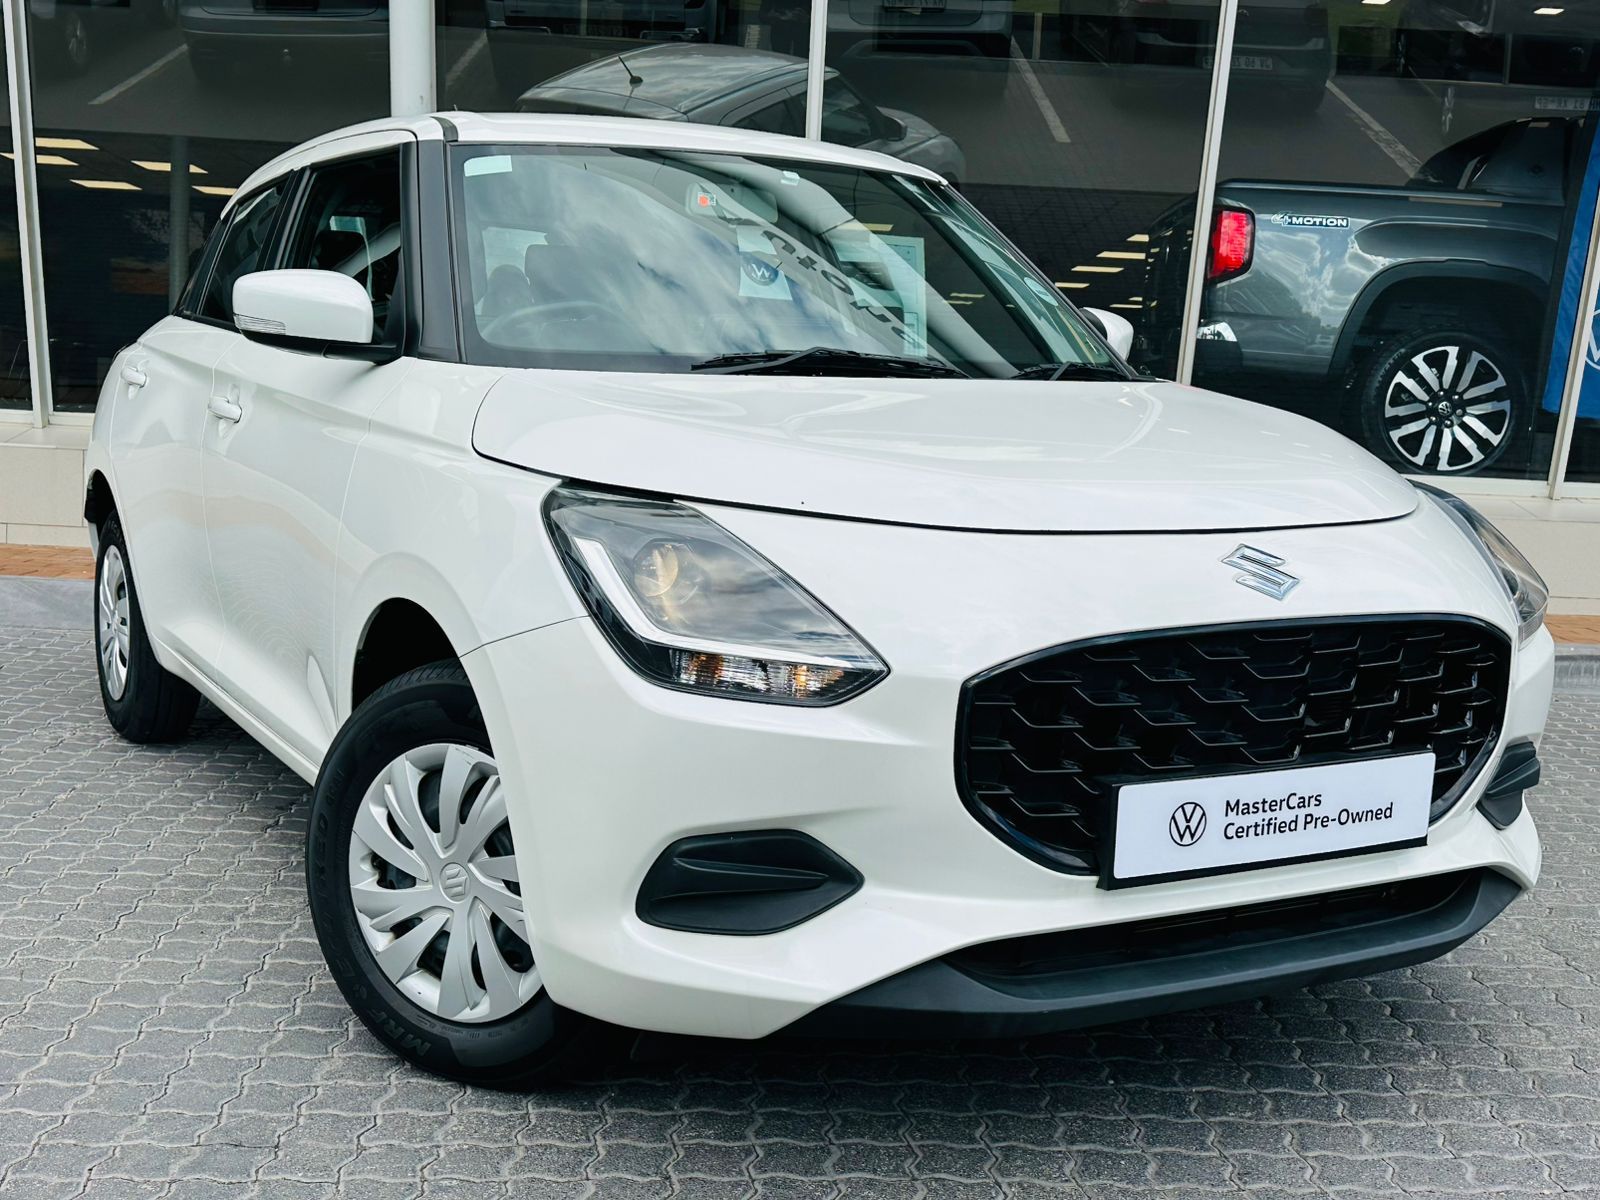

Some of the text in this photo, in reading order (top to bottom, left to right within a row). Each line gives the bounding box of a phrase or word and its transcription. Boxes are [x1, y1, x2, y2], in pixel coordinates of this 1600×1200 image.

[1225, 793, 1322, 817] MasterCars
[1223, 802, 1394, 840] Certified Pre-Owned
